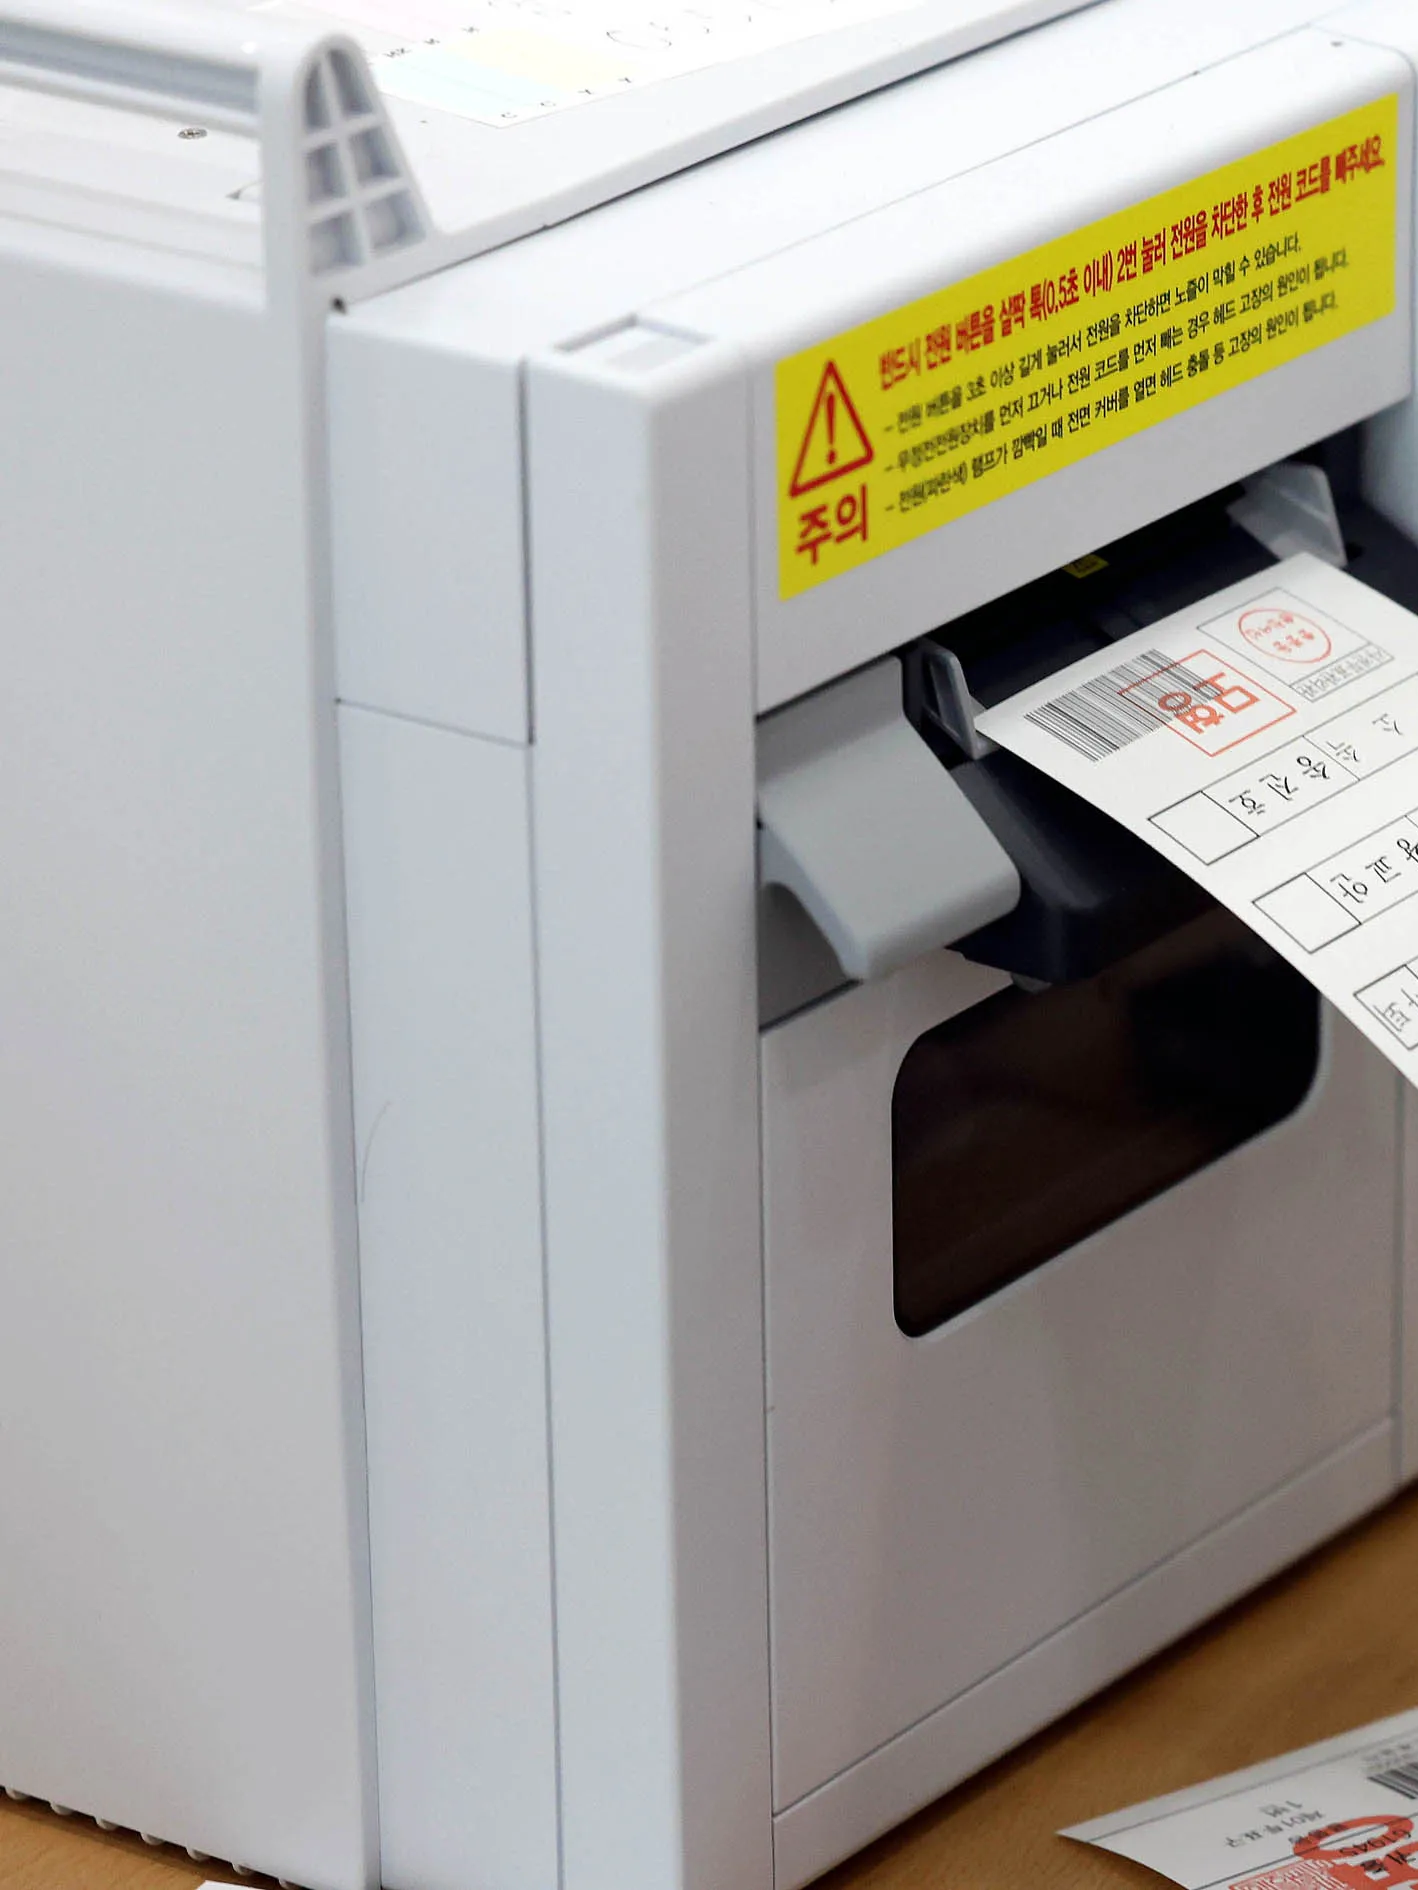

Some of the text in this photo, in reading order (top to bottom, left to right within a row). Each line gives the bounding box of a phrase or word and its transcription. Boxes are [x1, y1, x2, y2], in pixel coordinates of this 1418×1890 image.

[925, 325, 951, 370] 전원
[1083, 250, 1113, 297] 이내)
[1116, 240, 1137, 283] 2번
[1141, 227, 1166, 274] 눌러
[1170, 210, 1208, 260] 전원을
[1211, 191, 1248, 240] 차단한
[1251, 184, 1264, 223] 후
[1267, 172, 1292, 216] 전원
[1294, 155, 1331, 202] 코드를
[1046, 329, 1081, 366] 눌러서
[1086, 313, 1121, 347] 전원을
[1124, 289, 1170, 328] 차단하면
[1212, 259, 1235, 287] 막힐
[1238, 255, 1250, 276] 수
[1254, 232, 1301, 270] 있습니다.
[1067, 364, 1090, 394] 전원
[1094, 347, 1129, 381] 코드를
[1133, 334, 1156, 364] 먼저
[1187, 311, 1210, 339] 경우
[1213, 299, 1236, 325] 헤드
[1239, 280, 1273, 314] 고장의
[1067, 403, 1090, 433] 전면
[1095, 385, 1129, 418] 커버를
[1133, 372, 1156, 403] 열면
[1160, 362, 1183, 387] 헤드
[1228, 323, 1262, 357] 고장의
[796, 484, 868, 565] 주의
[1157, 671, 1260, 734] 모형
[1228, 756, 1329, 815] 송진호
